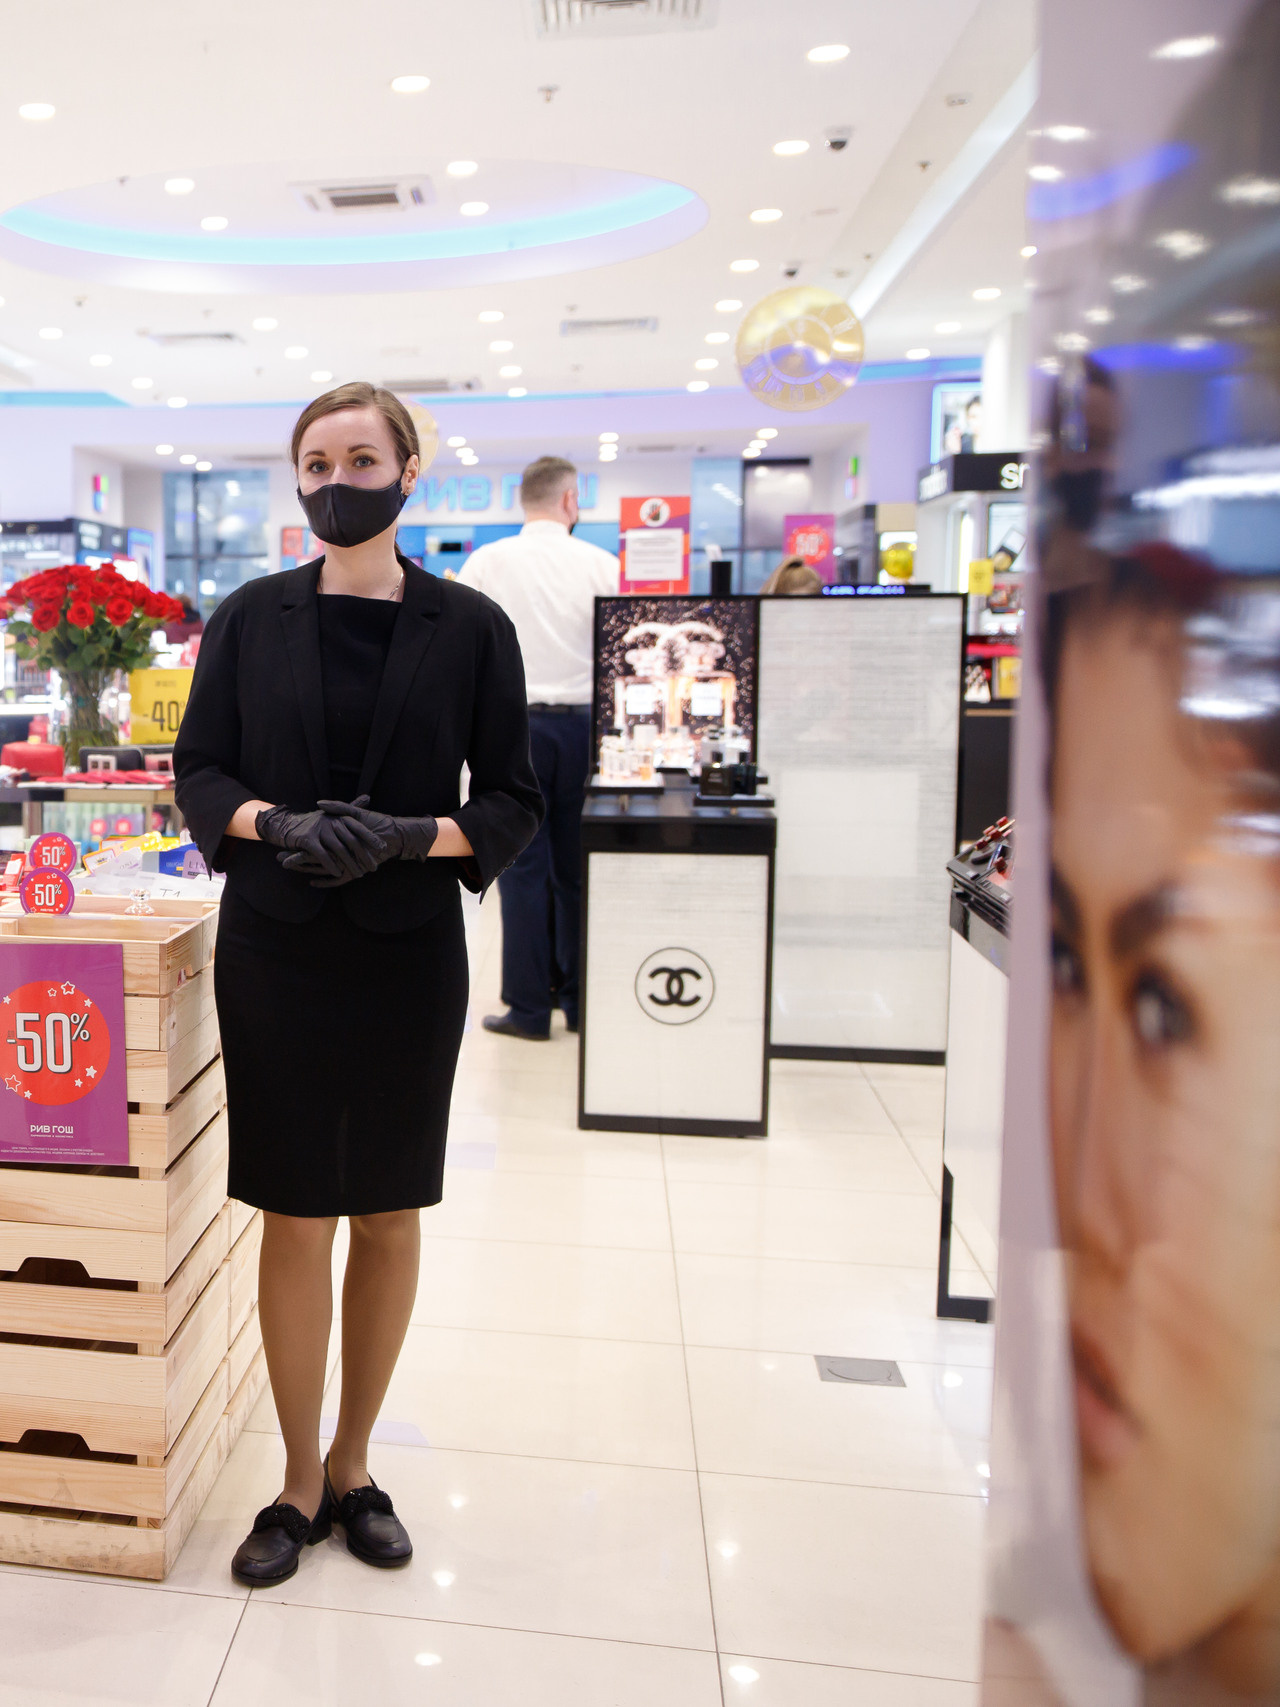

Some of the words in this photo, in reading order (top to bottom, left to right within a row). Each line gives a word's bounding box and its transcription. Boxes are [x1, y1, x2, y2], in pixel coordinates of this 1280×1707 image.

[501, 473, 599, 510] ГШ
[39, 846, 66, 867] -50%
[32, 883, 62, 907] -50%
[6, 1012, 91, 1075] -50%
[30, 1124, 51, 1133] РИВ
[52, 1125, 74, 1134] ГОШ
